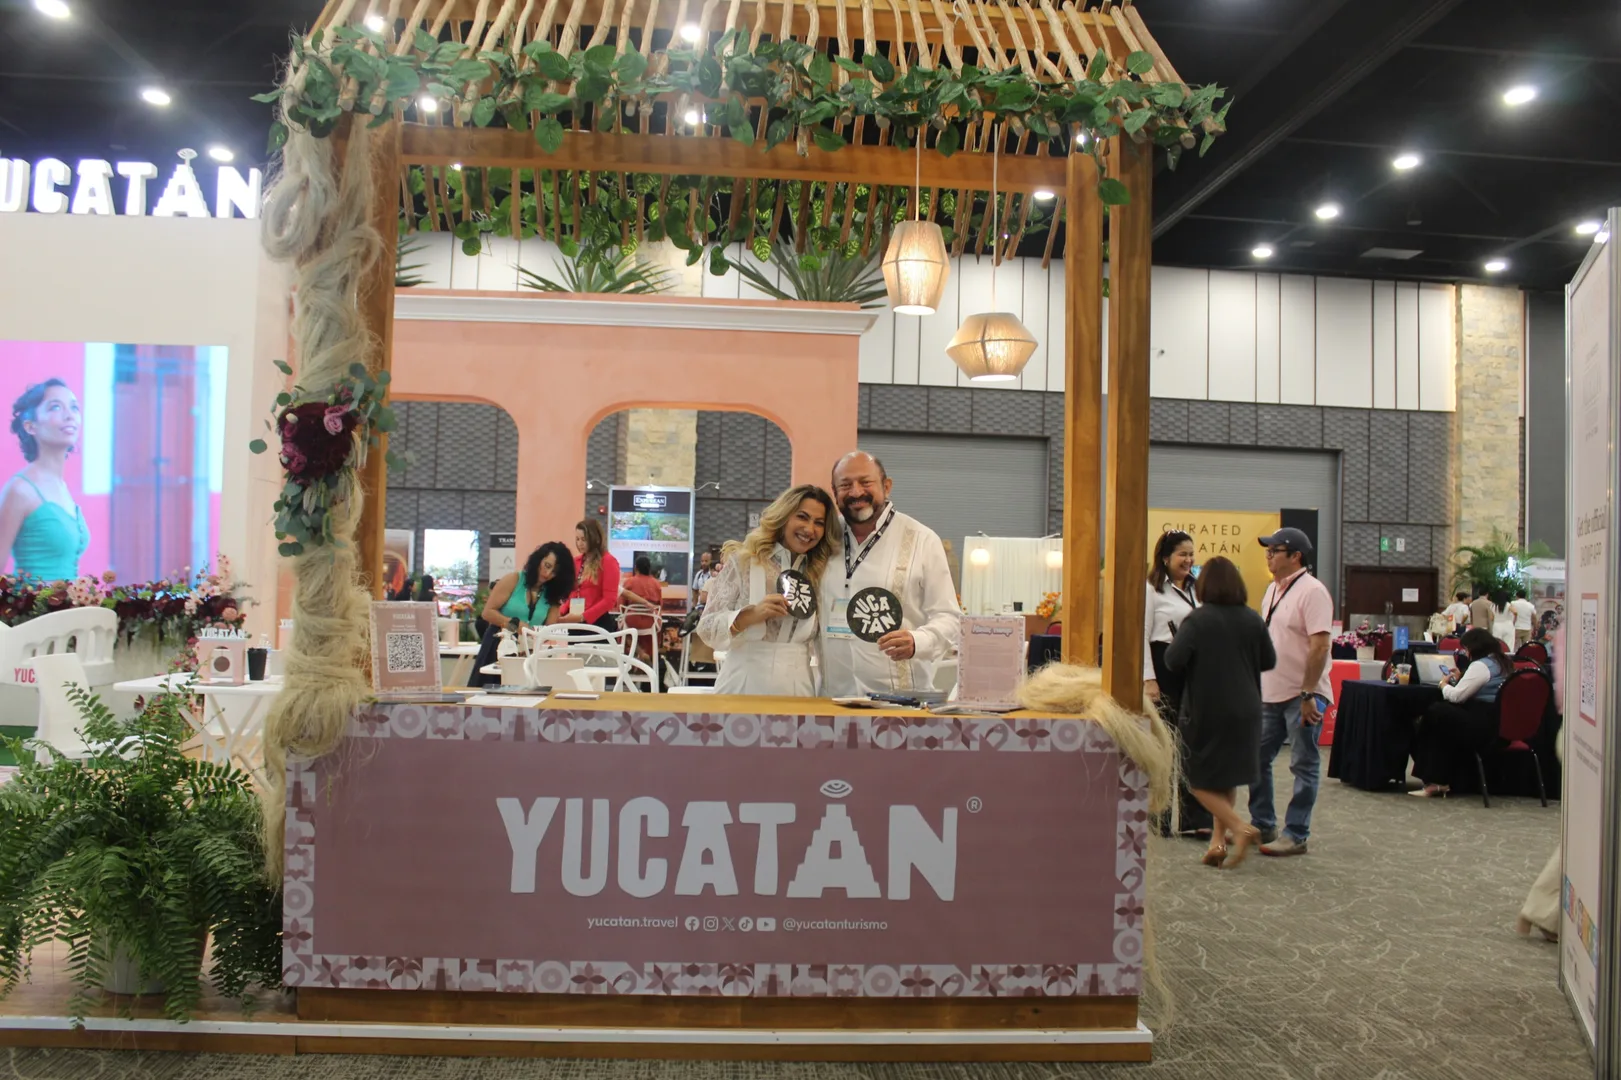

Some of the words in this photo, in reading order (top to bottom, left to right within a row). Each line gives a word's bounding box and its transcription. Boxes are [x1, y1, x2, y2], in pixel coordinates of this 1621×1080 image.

[0, 148, 262, 219] UCATÁN
[1198, 541, 1241, 553] ATÁN
[587, 916, 678, 929] yucatan.travel
[783, 917, 888, 932] @yucatanturismo
